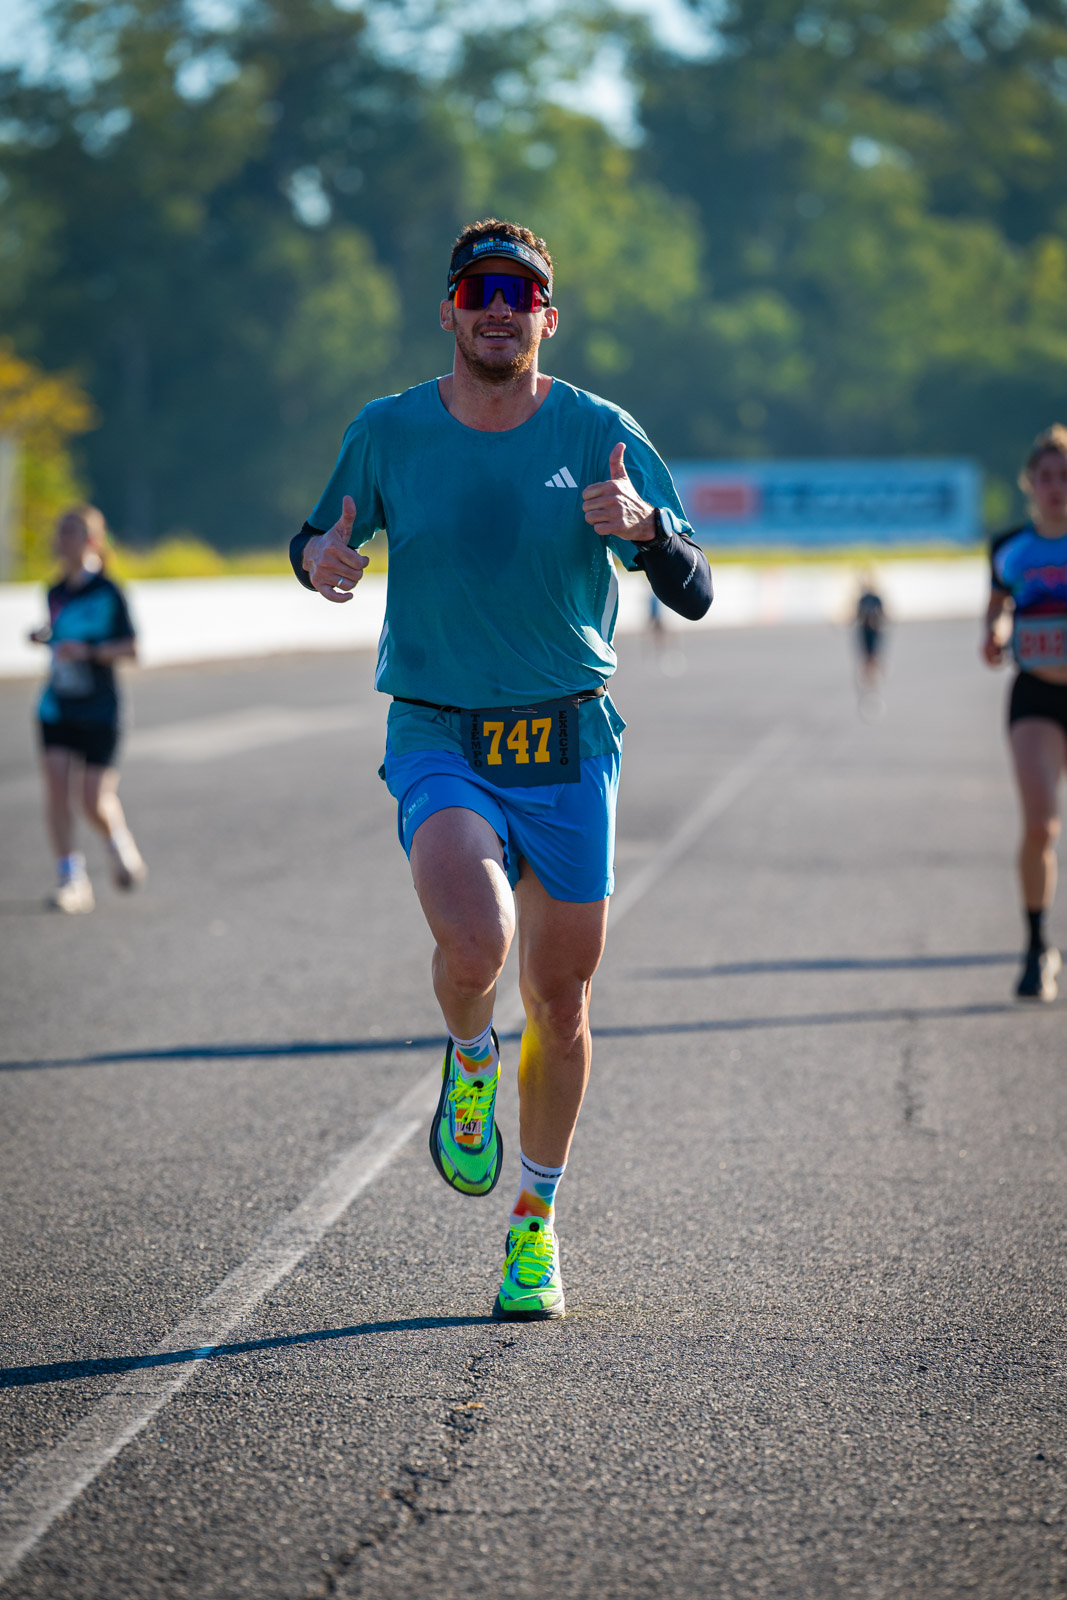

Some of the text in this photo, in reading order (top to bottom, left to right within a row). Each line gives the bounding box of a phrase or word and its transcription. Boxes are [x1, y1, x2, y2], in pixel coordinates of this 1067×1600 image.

[470, 713, 483, 769] TIEMPO
[483, 717, 552, 766] 747
[558, 710, 569, 766] EXACTO
[461, 1121, 477, 1132] 747
